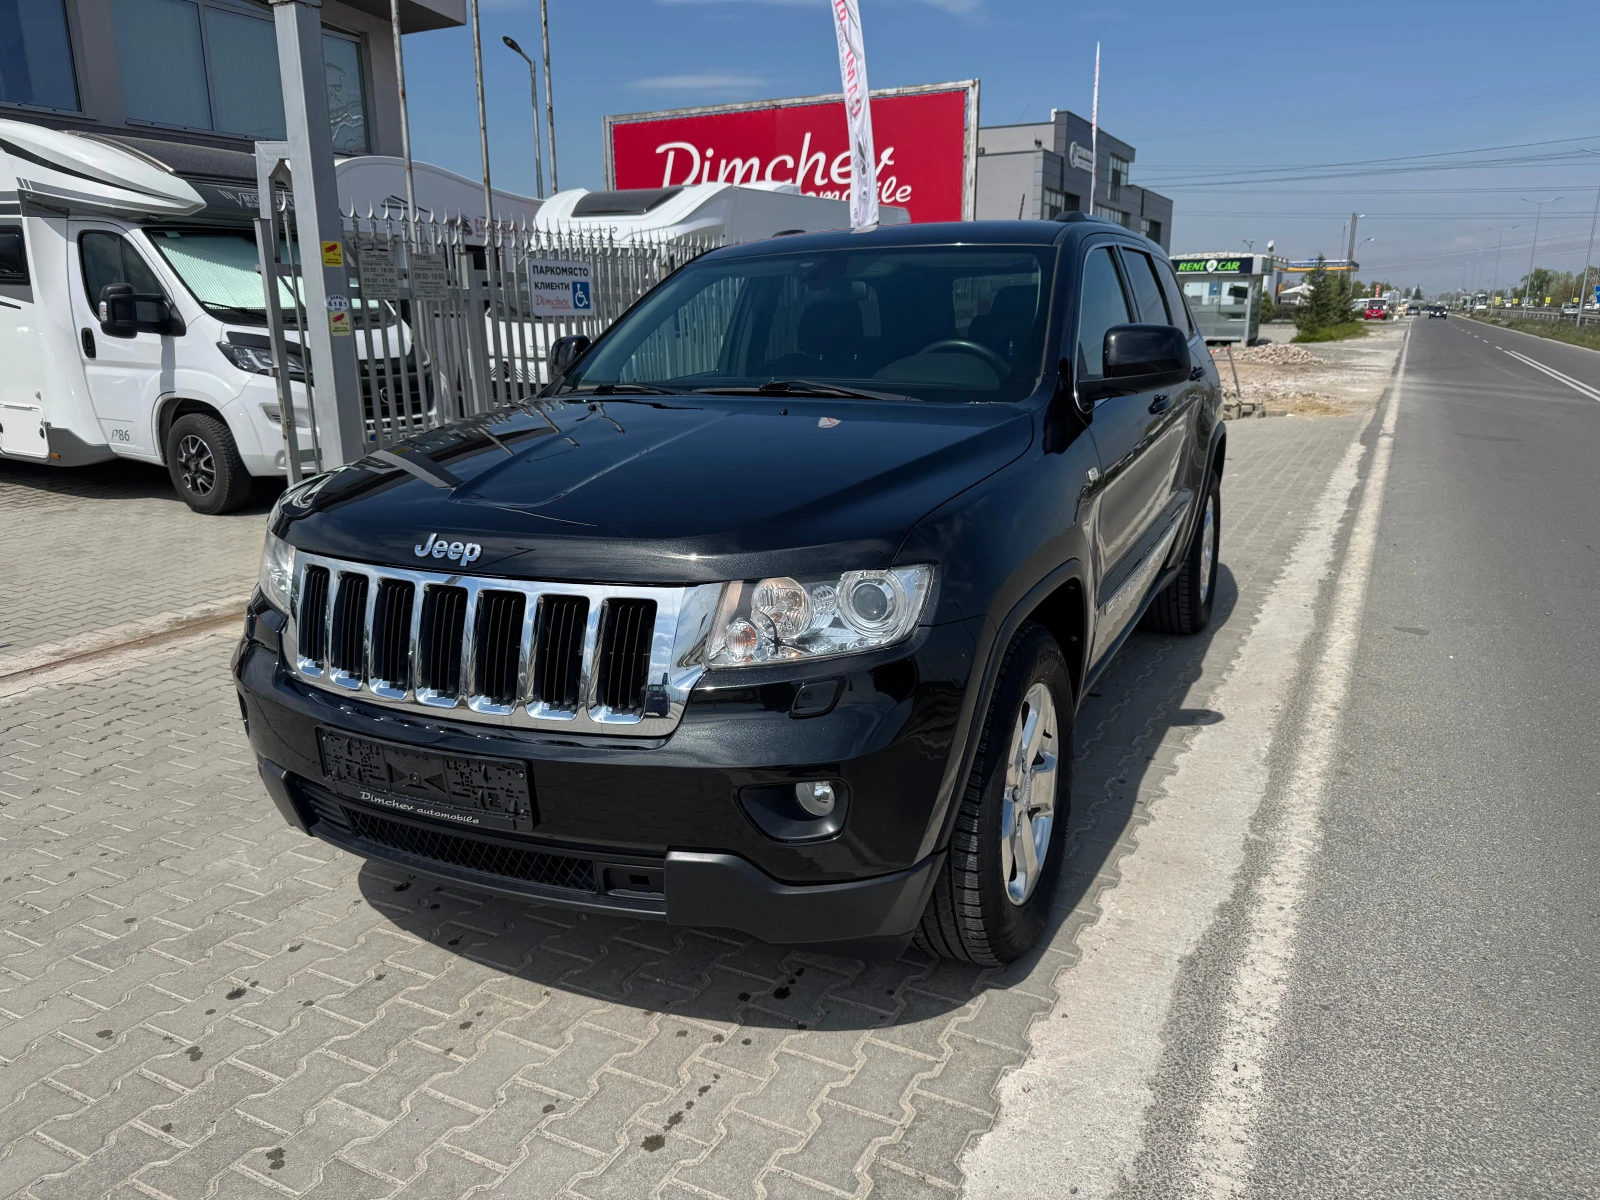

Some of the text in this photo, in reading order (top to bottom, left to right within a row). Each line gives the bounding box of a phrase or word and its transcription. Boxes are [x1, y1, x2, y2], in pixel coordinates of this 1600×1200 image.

[532, 265, 589, 277] ПАРКОМЯСТО
[1178, 261, 1206, 271] RENT
[1218, 261, 1240, 271] CAR
[534, 282, 570, 291] КЛИЕНТИ
[535, 294, 569, 306] Dimchev
[111, 429, 130, 441] P86
[414, 532, 482, 567] Jeep
[360, 791, 480, 824] Dimchev automobile
